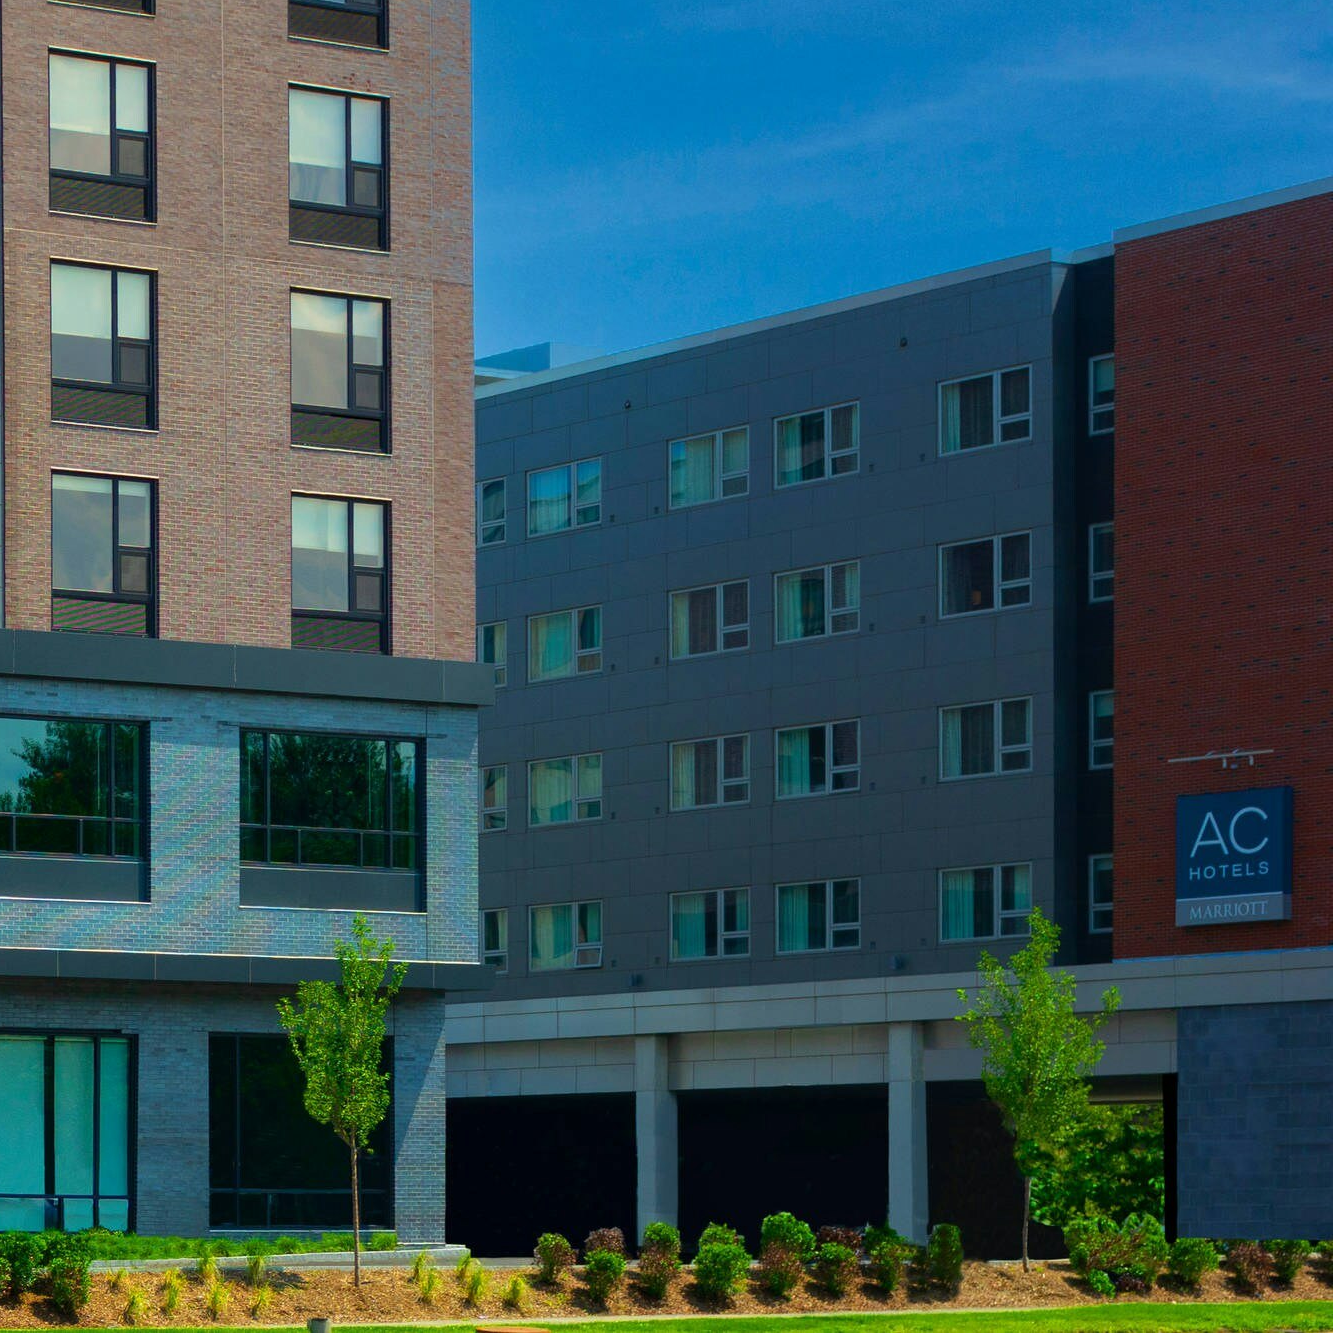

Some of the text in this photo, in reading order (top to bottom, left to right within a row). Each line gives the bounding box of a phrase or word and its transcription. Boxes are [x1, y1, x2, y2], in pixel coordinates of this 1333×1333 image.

[1190, 806, 1269, 858] AC
[1189, 861, 1270, 881] HOTELS
[1189, 900, 1269, 921] MARRIOTT
